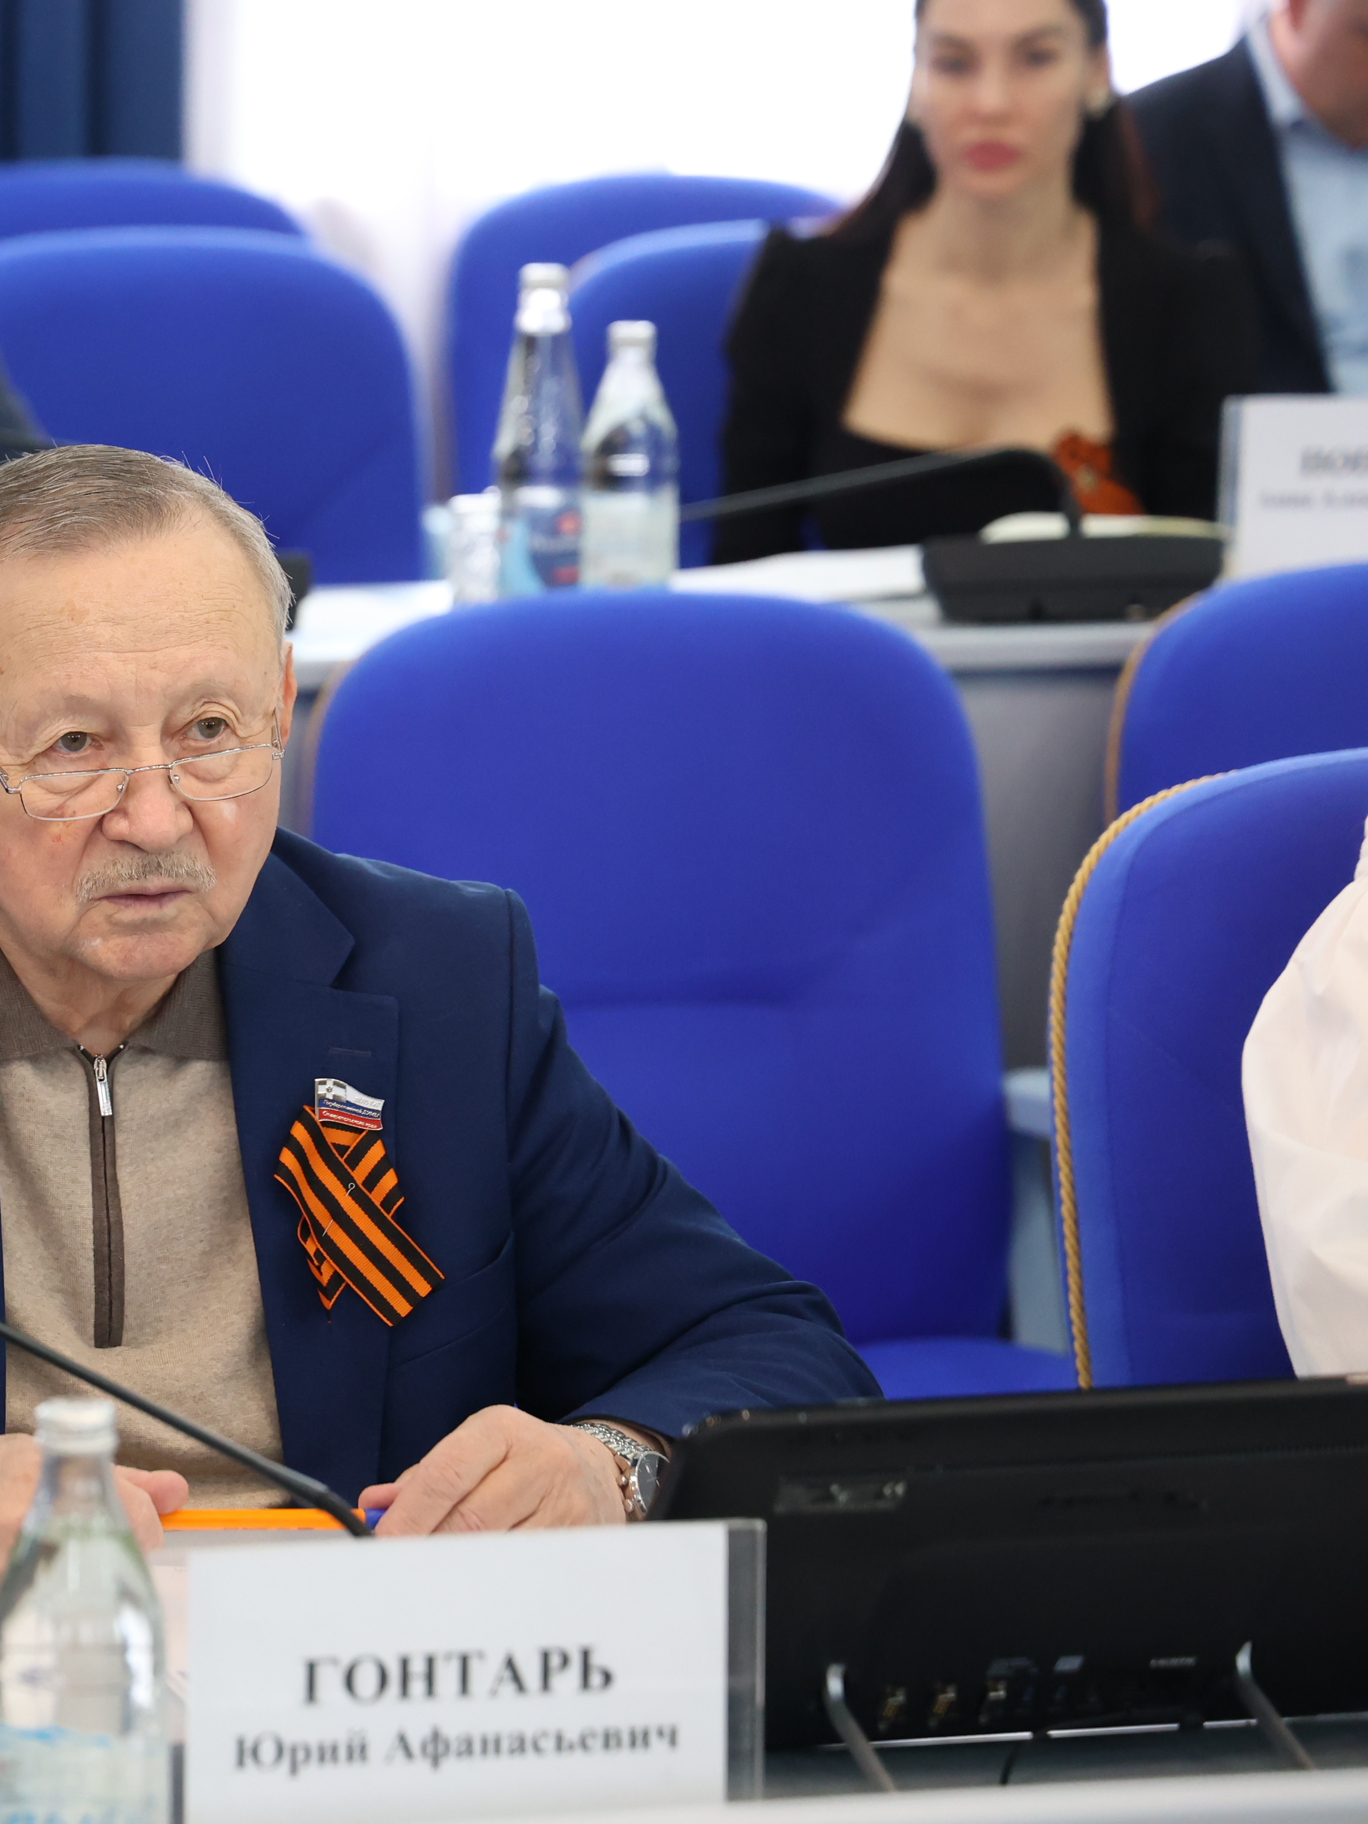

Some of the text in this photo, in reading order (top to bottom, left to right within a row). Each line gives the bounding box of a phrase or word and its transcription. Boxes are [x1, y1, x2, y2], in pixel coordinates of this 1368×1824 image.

[303, 1644, 615, 1705] ГОНТАРЬ
[234, 1721, 680, 1778] Юрий Афанасьевич
